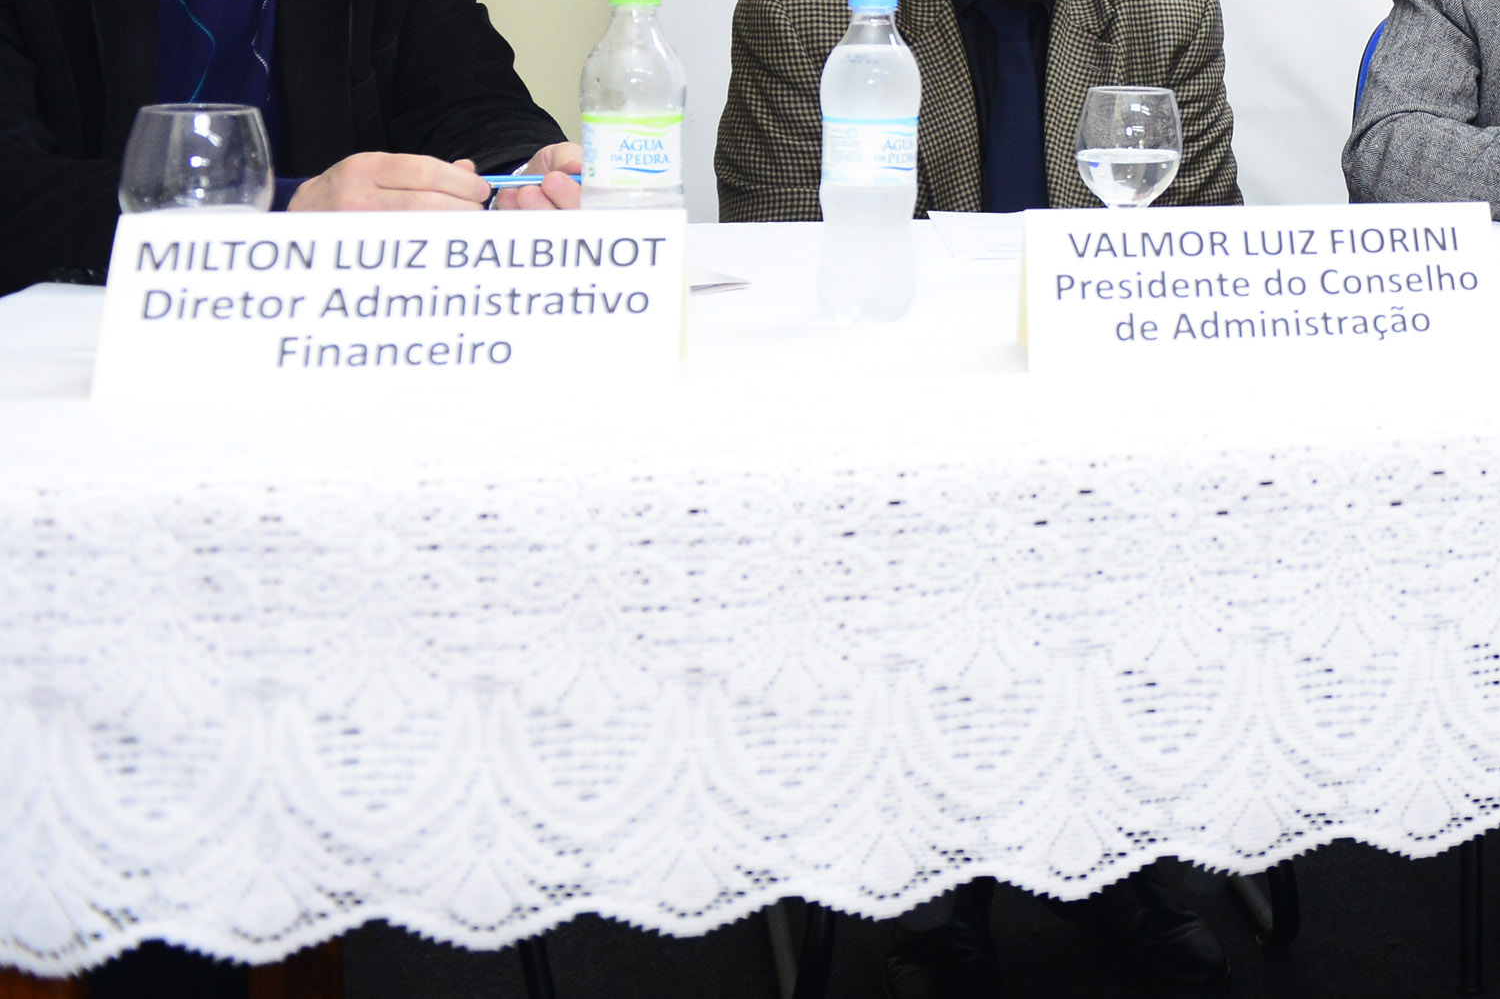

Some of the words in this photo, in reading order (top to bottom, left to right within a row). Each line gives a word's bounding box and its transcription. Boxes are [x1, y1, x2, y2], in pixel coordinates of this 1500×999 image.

[618, 135, 665, 152] ÁGUA
[625, 152, 671, 166] PEDRA
[135, 238, 316, 272] MILTON
[333, 238, 429, 271] LUIZ
[444, 236, 667, 269] BALBINOT
[1067, 230, 1231, 259] VALMOR
[1243, 228, 1318, 257] LUIZ
[1329, 225, 1459, 255] FIORINI
[1055, 269, 1251, 301] Presidente
[1263, 268, 1308, 297] do
[1319, 264, 1480, 296] Conselho
[141, 287, 306, 321] Diretor
[319, 282, 651, 320] Administrativo
[1115, 312, 1159, 342] de
[1172, 305, 1432, 342] Administração
[277, 332, 514, 368] Financeiro
